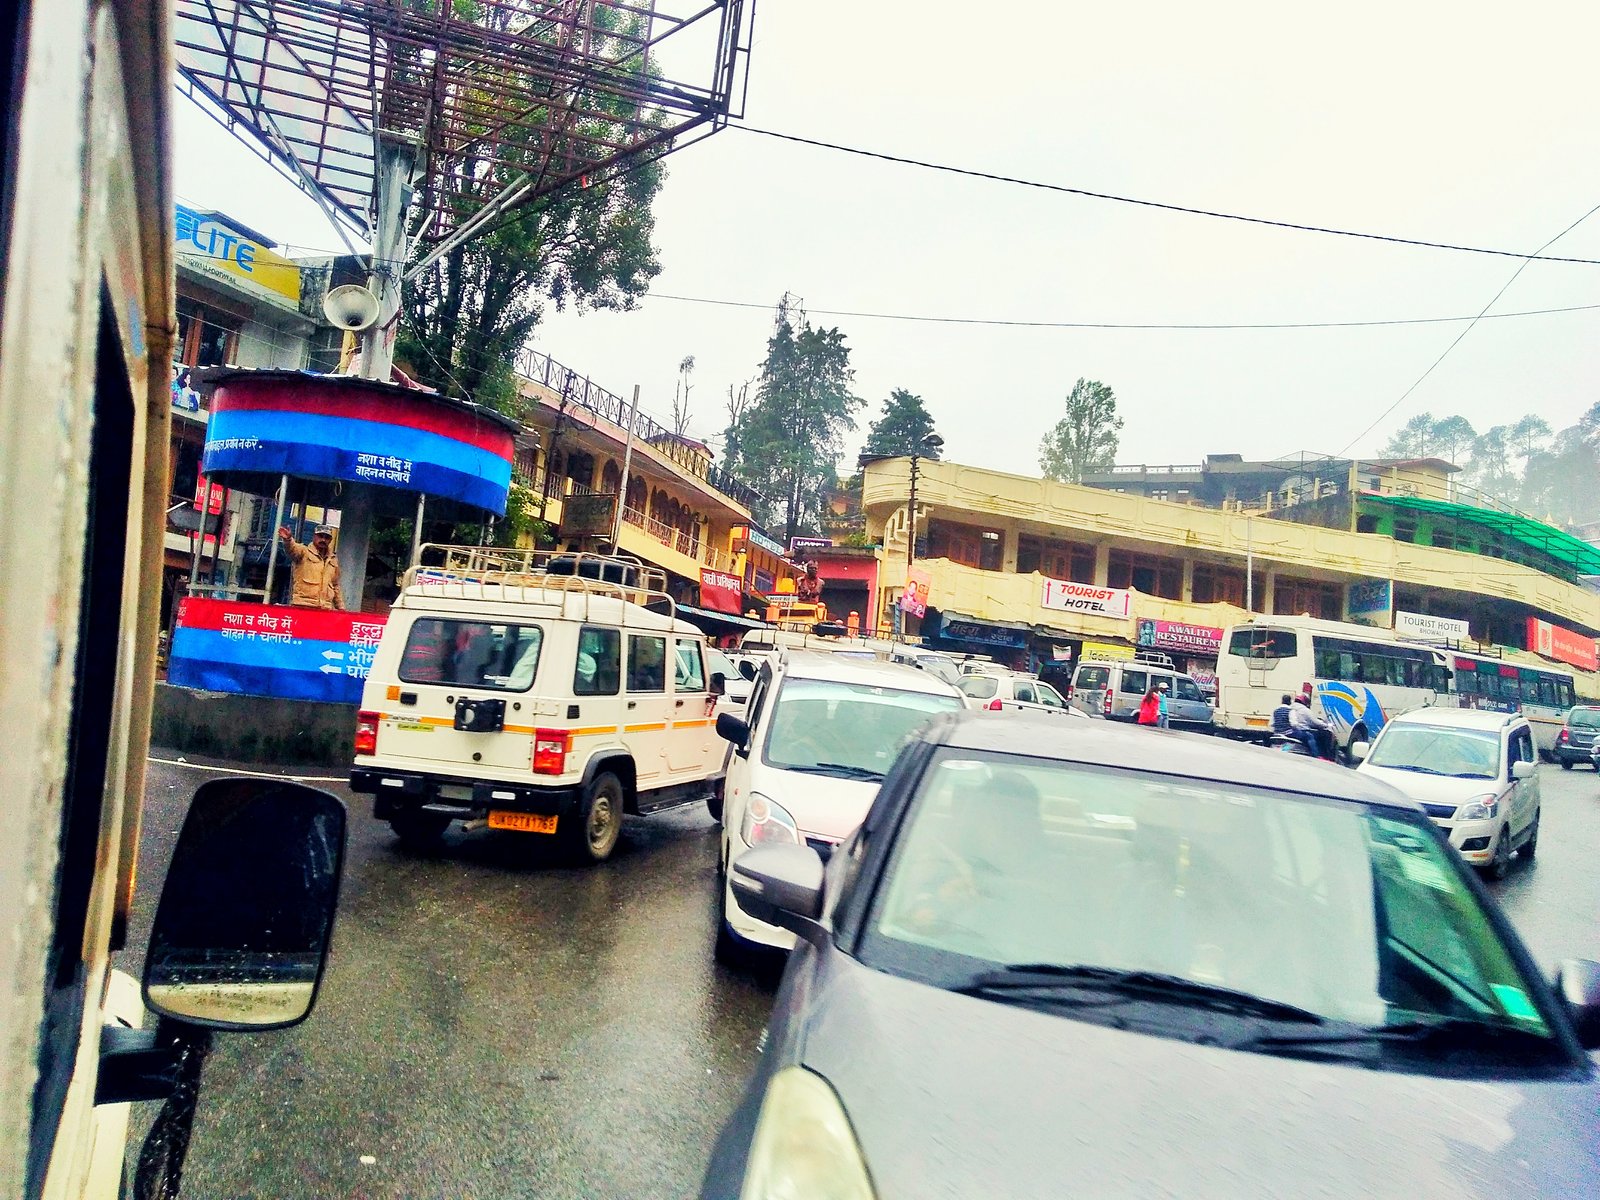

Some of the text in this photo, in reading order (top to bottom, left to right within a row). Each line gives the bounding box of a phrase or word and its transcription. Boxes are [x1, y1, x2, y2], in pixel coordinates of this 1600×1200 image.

[358, 453, 378, 465] नशा
[378, 456, 386, 467] व
[356, 465, 379, 480] वाहन
[378, 469, 387, 479] न
[1060, 584, 1114, 601] TOURIST
[1064, 598, 1106, 612] HOTEL
[223, 612, 243, 625] नशा
[245, 614, 254, 625] व
[1404, 616, 1462, 633] TOURIST HOTEL
[221, 627, 245, 642] वाहन
[247, 630, 256, 640] न
[1168, 624, 1213, 638] KWALITY
[1157, 631, 1222, 648] RESTAURENT
